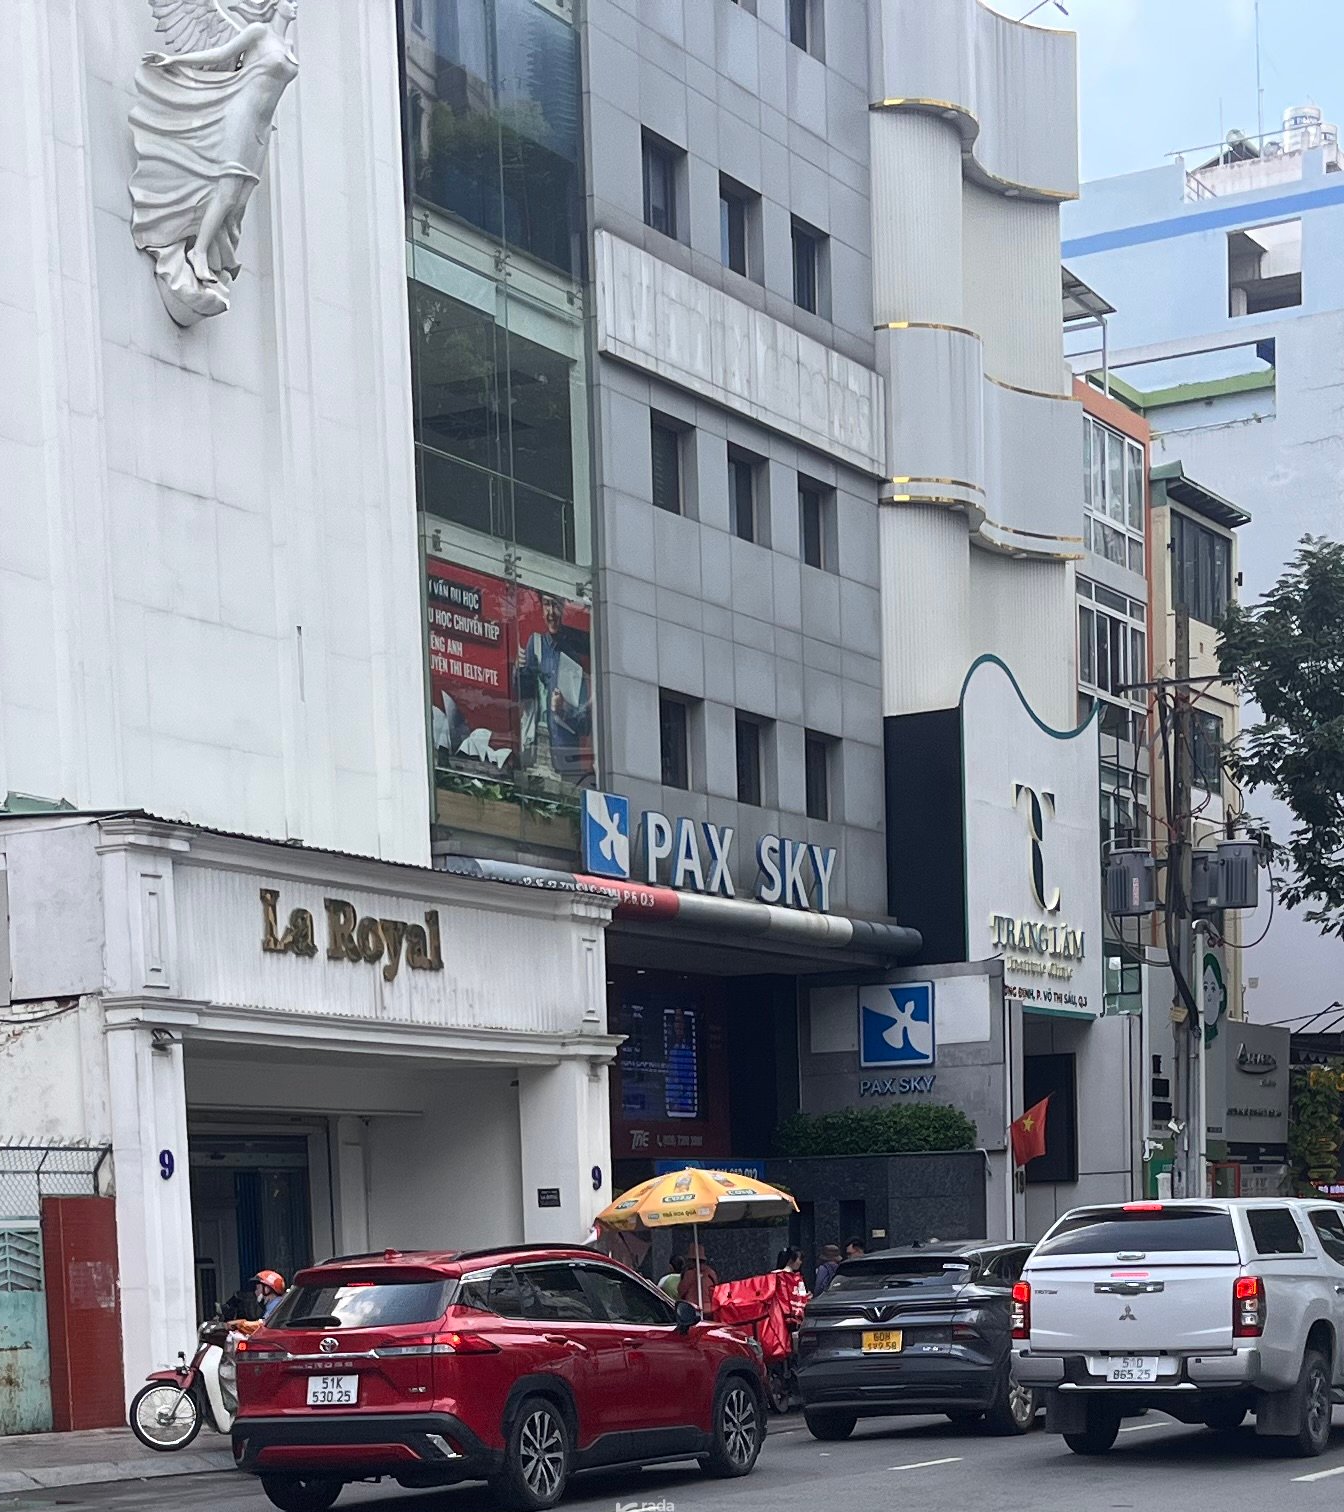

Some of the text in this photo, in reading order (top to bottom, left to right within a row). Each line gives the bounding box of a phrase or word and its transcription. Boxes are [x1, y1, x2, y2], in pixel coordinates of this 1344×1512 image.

[463, 590, 479, 611] HỌC
[435, 608, 452, 629] HỌC
[484, 620, 500, 641] TIẾP
[447, 639, 463, 657] ANH
[449, 659, 463, 676] THI
[463, 662, 499, 686] IELTS/PTE
[642, 810, 837, 912] PAX SKY
[260, 888, 445, 983] La Royal
[989, 915, 1086, 960] TRANG LÂM
[860, 1075, 936, 1097] PAX SKY
[159, 1149, 175, 1180] 9
[591, 1165, 602, 1191] 9
[322, 1376, 343, 1389] 51K
